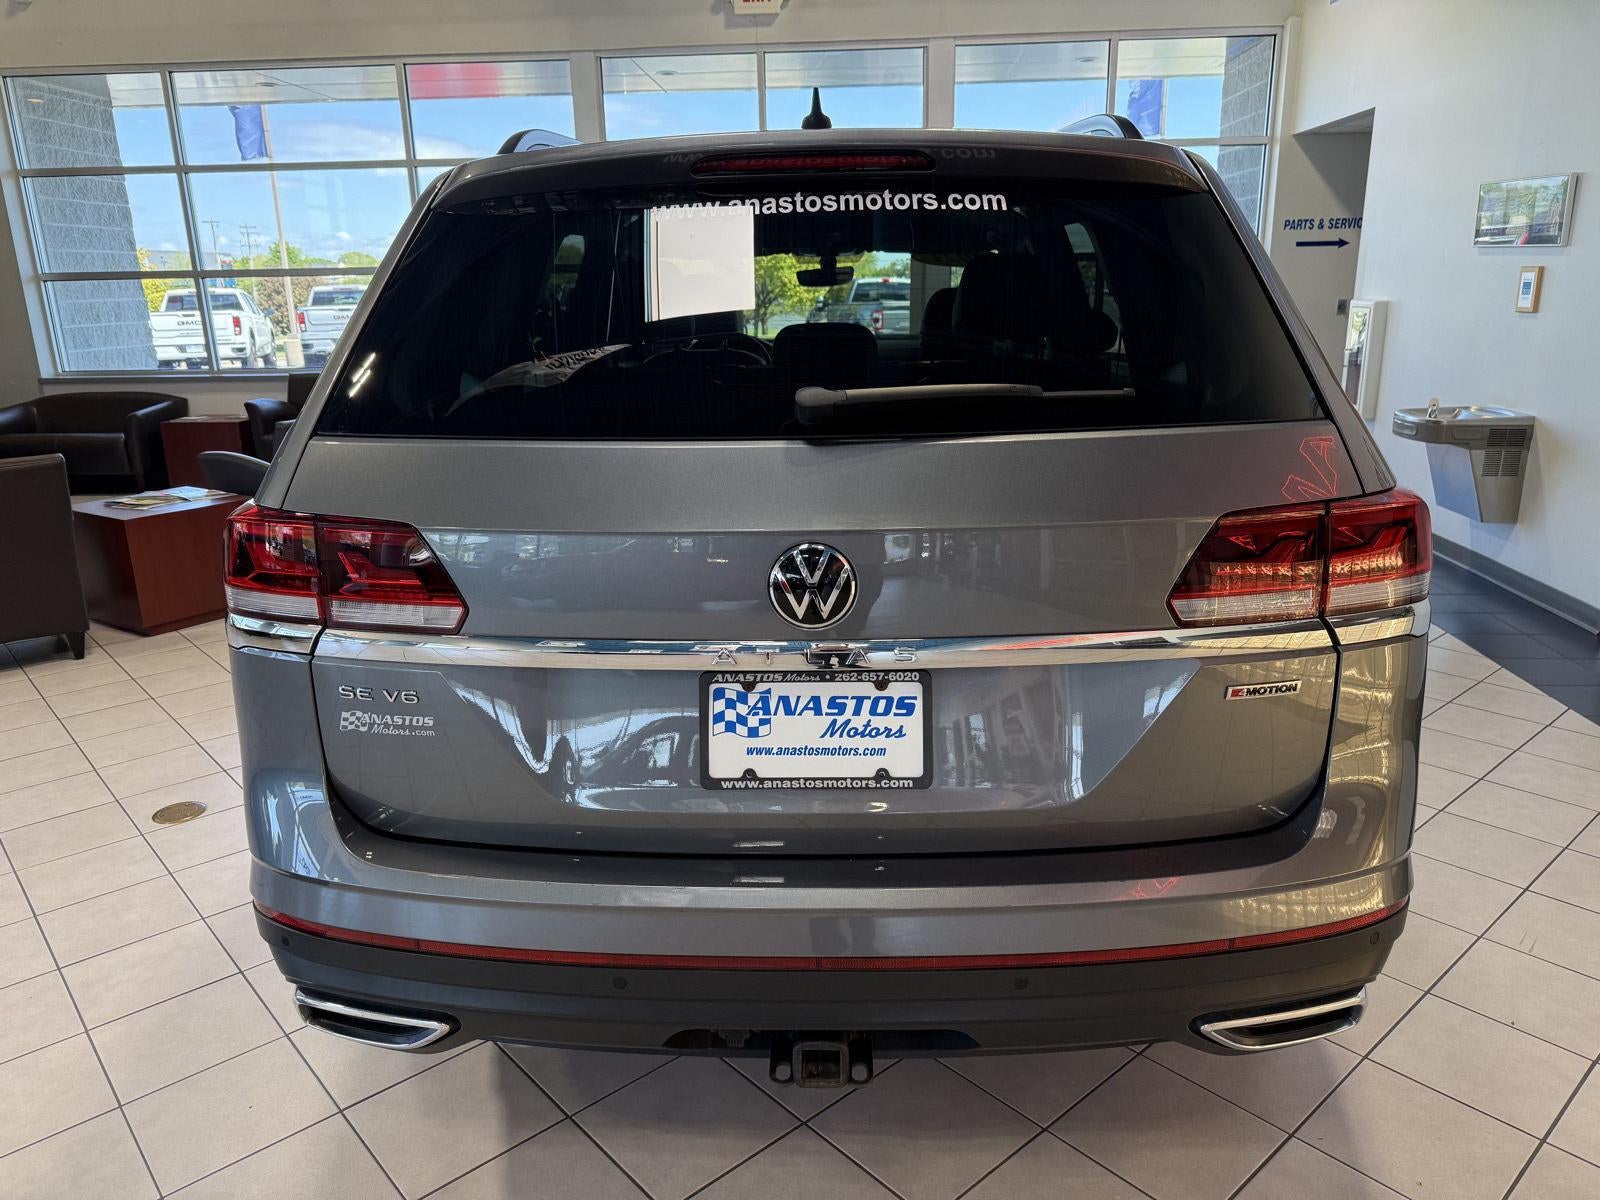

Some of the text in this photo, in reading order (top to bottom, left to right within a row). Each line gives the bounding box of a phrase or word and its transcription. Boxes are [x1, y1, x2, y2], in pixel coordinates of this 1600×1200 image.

[652, 189, 1008, 221] www.anastosmotors.com
[1283, 216, 1363, 231] PARTS & SERVIC
[712, 646, 918, 666] ATLAS
[712, 672, 920, 683] ANASTOS Motors 262-657-6020
[338, 685, 420, 704] SE V6
[745, 694, 917, 717] ANASTOS
[359, 712, 435, 727] ANASTOS
[819, 718, 907, 739] Motors
[746, 745, 887, 757] www.anastosmotors.com
[721, 777, 913, 789] www.anastosmotors.com
